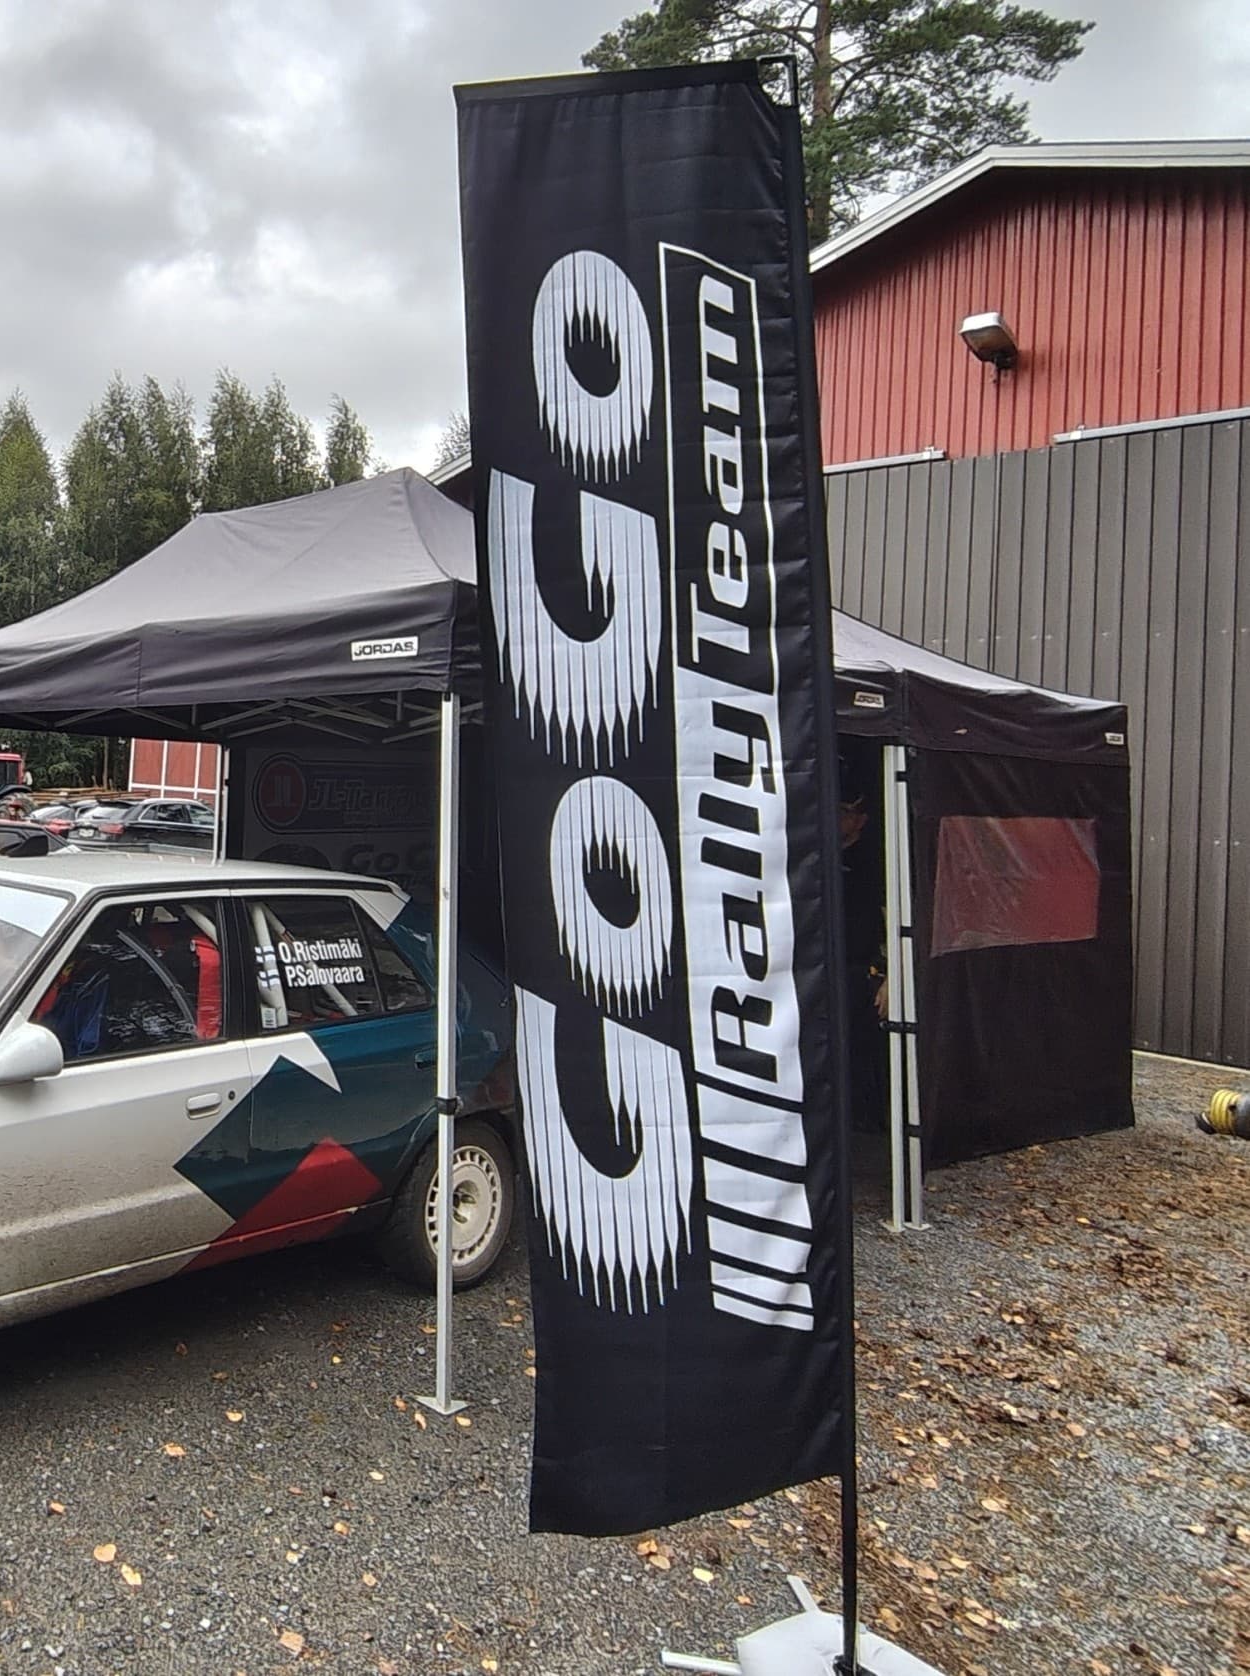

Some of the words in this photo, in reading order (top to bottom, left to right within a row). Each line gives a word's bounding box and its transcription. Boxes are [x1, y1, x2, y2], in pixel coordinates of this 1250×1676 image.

[354, 641, 415, 656] JORDAS
[277, 938, 363, 963] O.Ristimäki
[284, 964, 366, 988] P.Salovaara
